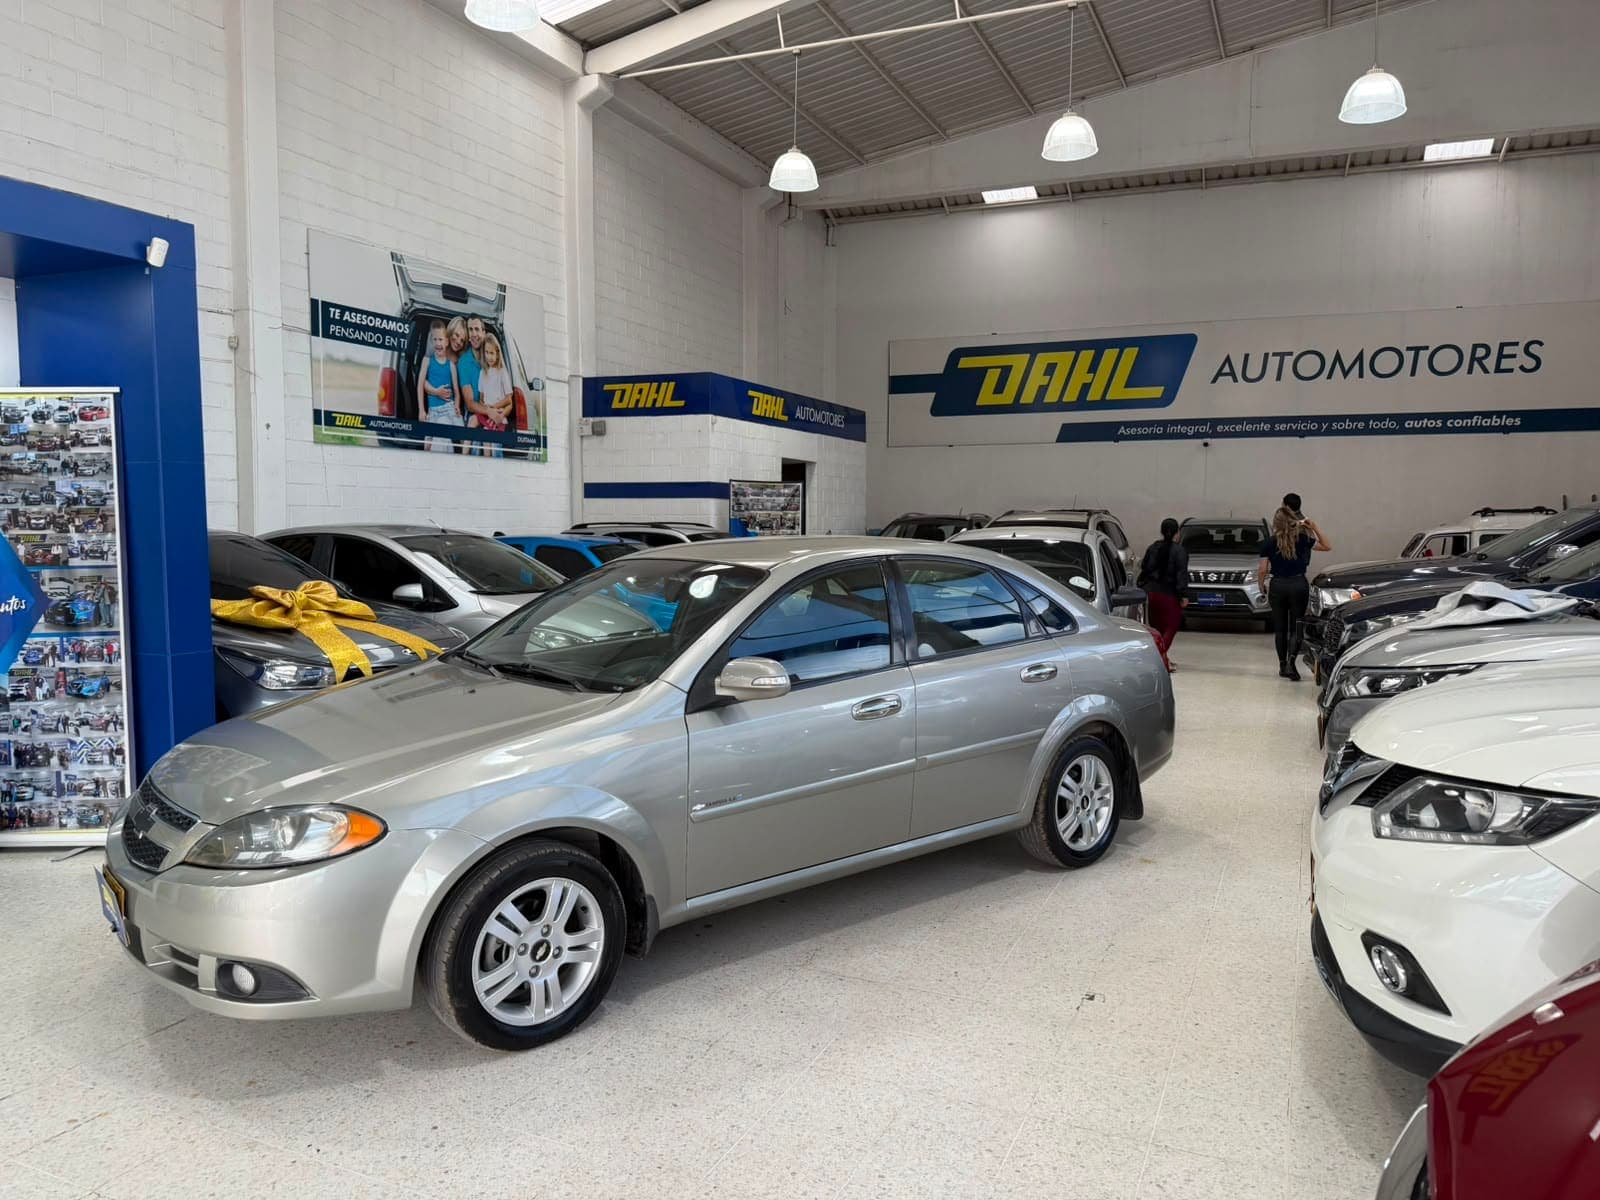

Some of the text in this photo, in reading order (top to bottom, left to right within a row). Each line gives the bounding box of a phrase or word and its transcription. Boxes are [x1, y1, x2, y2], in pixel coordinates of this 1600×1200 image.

[329, 307, 410, 334] TE ASESORAMOS
[329, 324, 408, 349] PENSANDO EN TI
[957, 340, 1545, 406] DAHL AUTOMOTORES
[603, 381, 685, 409] DAHL
[747, 389, 845, 428] DAHL AUTOMOTORES
[331, 413, 413, 431] DAHL AUTOMOTORES
[1166, 421, 1213, 435] integral,
[1216, 421, 1272, 433] excelente
[1274, 419, 1318, 431] servicio
[1320, 423, 1329, 432] y
[1332, 418, 1365, 430] sobre
[1369, 417, 1400, 430] todo,
[1404, 418, 1443, 428] autos
[1447, 415, 1521, 428] confiables
